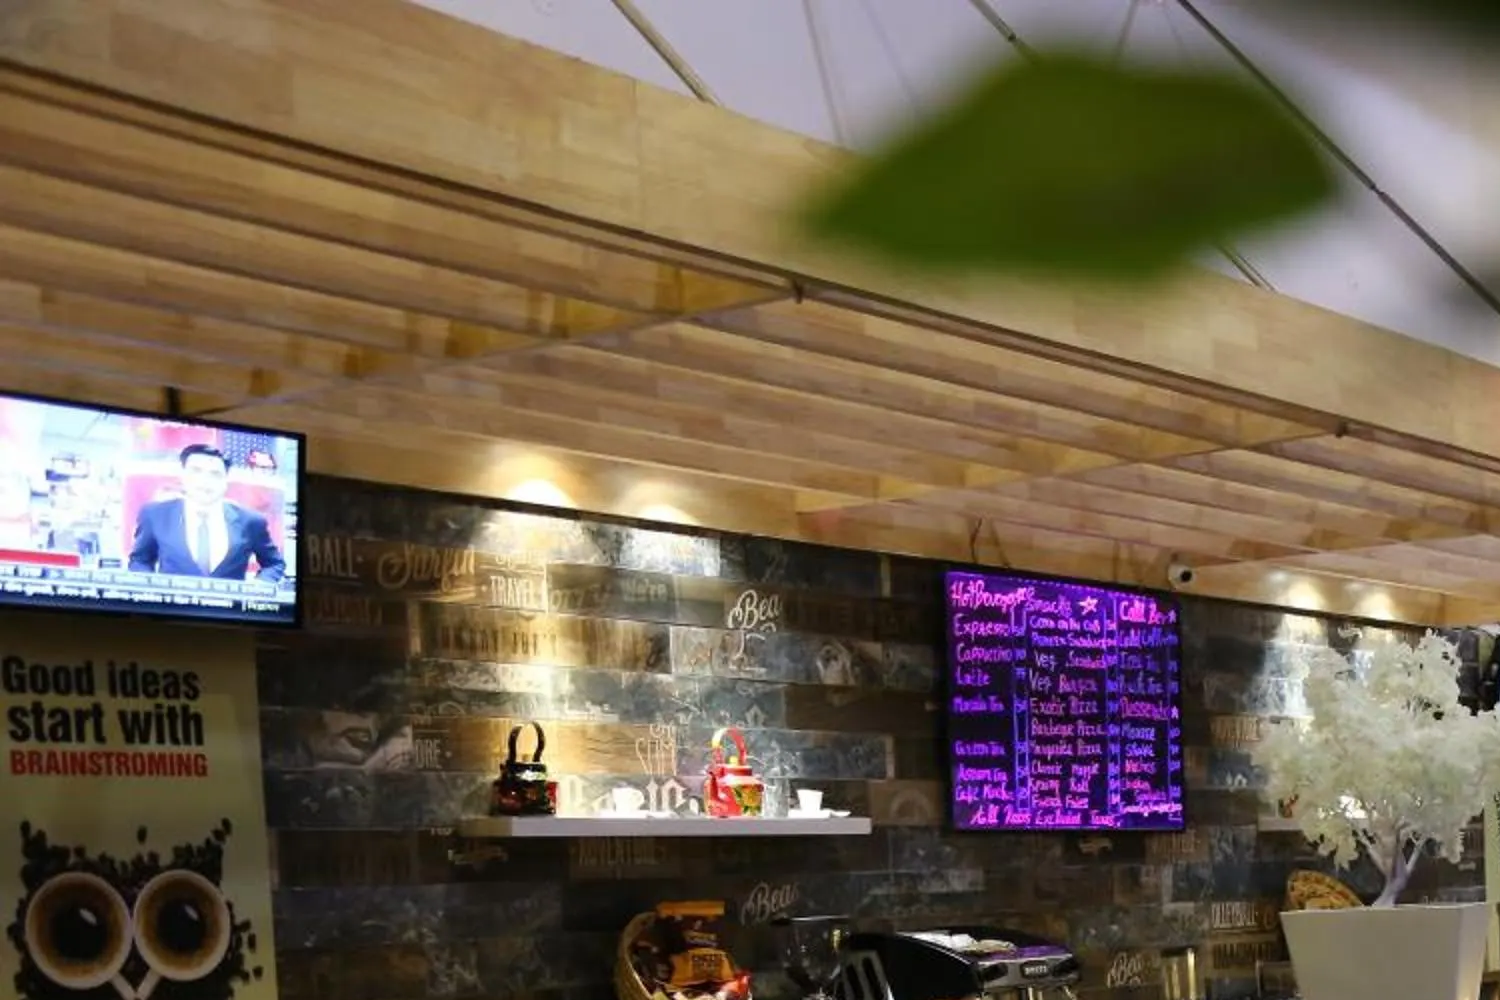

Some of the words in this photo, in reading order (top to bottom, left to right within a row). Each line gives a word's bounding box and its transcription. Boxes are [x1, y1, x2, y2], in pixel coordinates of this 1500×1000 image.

[2, 656, 95, 697] Good
[107, 660, 201, 701] ideas
[7, 701, 107, 744] start
[118, 703, 205, 747] with
[10, 750, 209, 778] BRAINSTROMING
